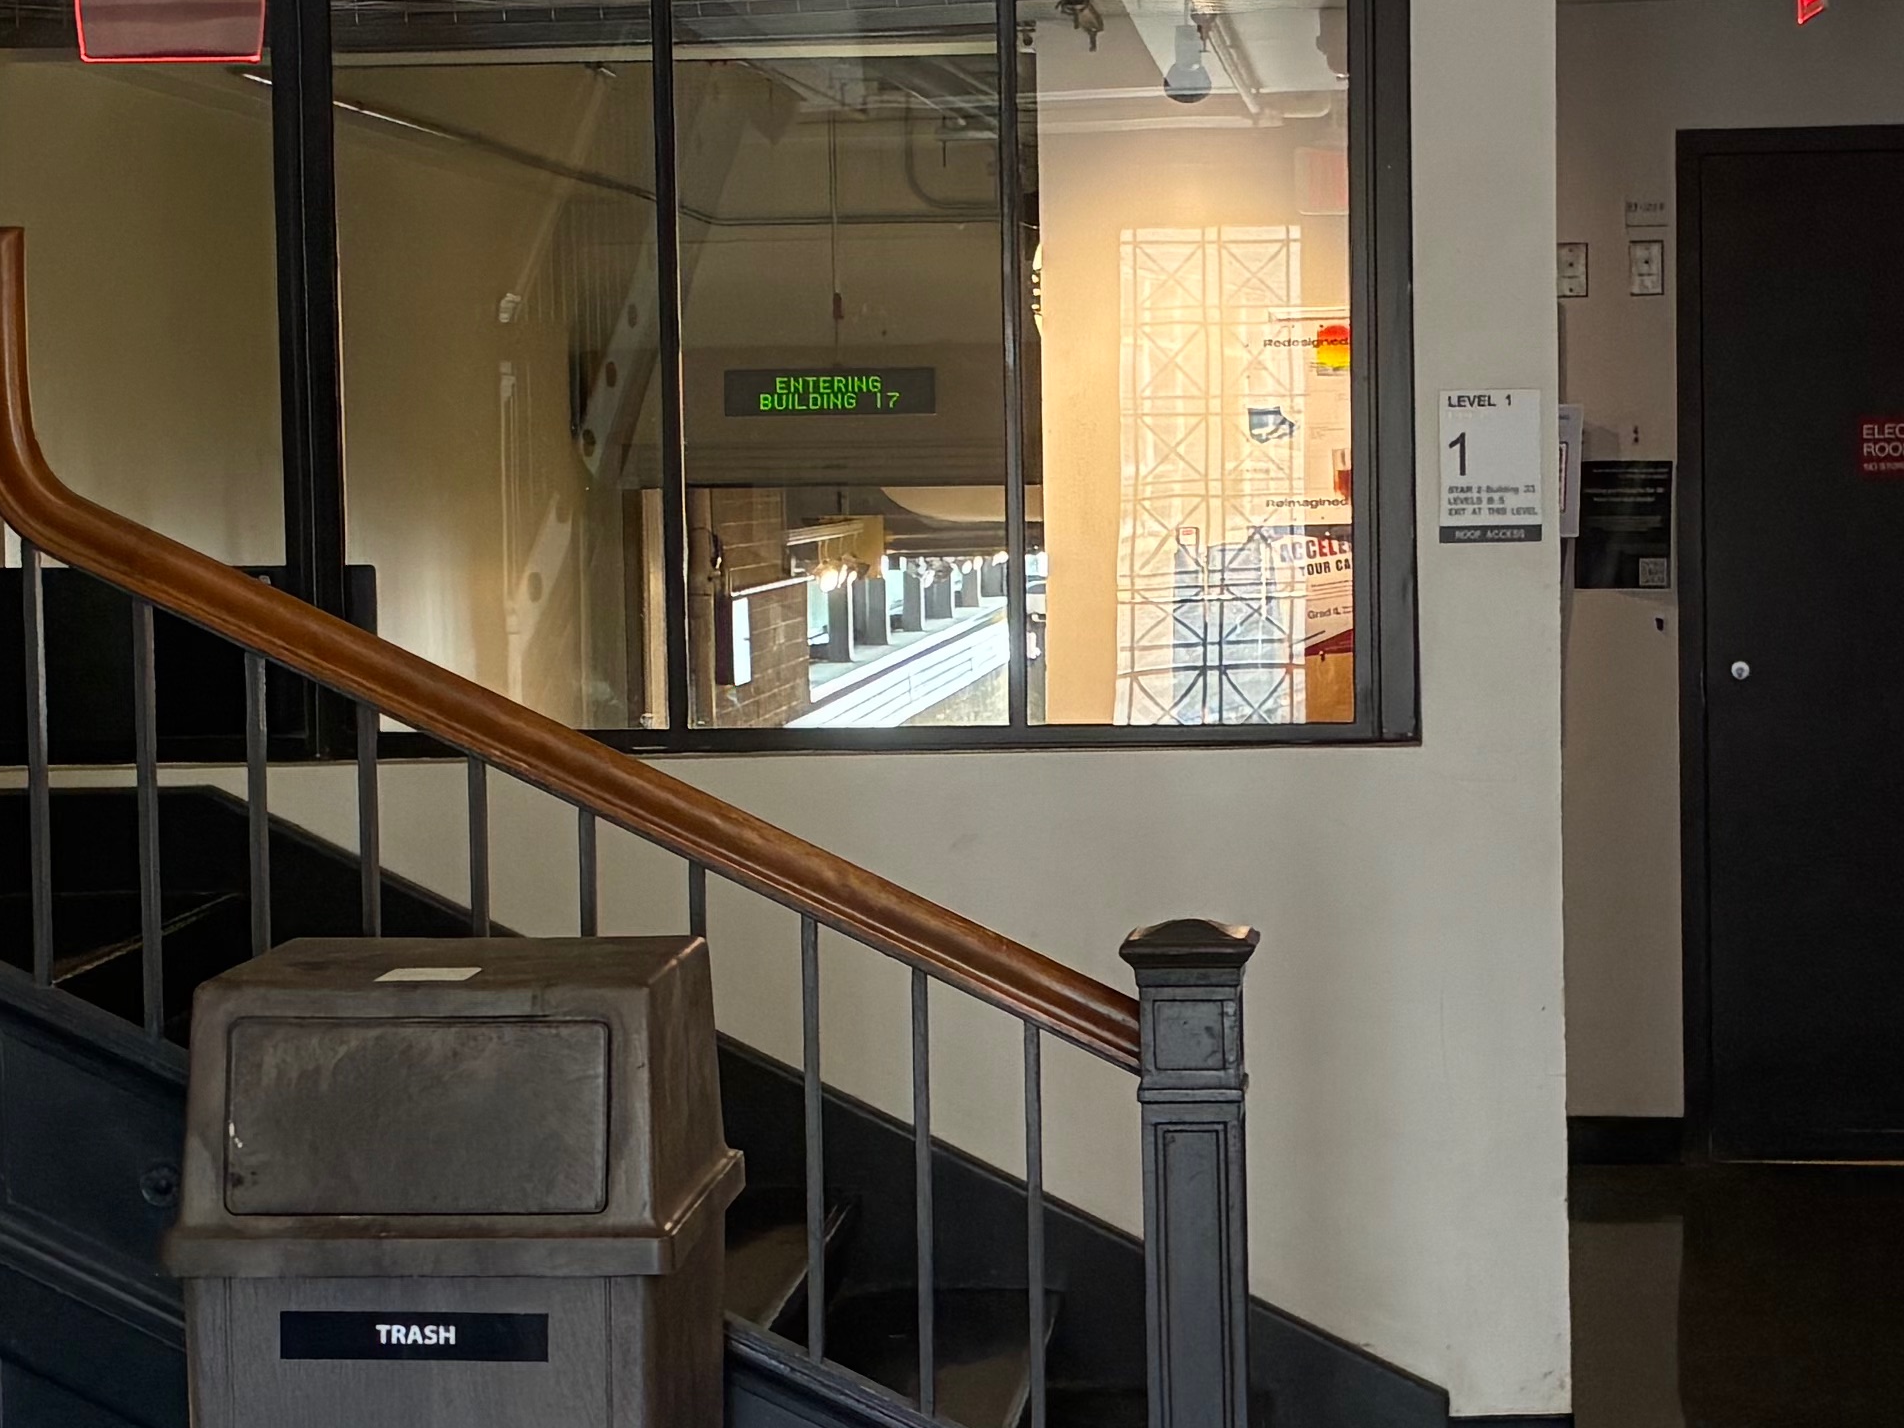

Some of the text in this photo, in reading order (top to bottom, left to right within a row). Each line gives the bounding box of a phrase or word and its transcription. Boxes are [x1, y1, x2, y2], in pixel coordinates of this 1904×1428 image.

[775, 376, 882, 394] ENTERING
[759, 392, 900, 410] BUILDING 17
[1447, 393, 1512, 408] LEVEL 1
[1448, 431, 1466, 476] 1
[1280, 539, 1352, 563] ACCELE
[375, 1324, 456, 1345] TRASH
